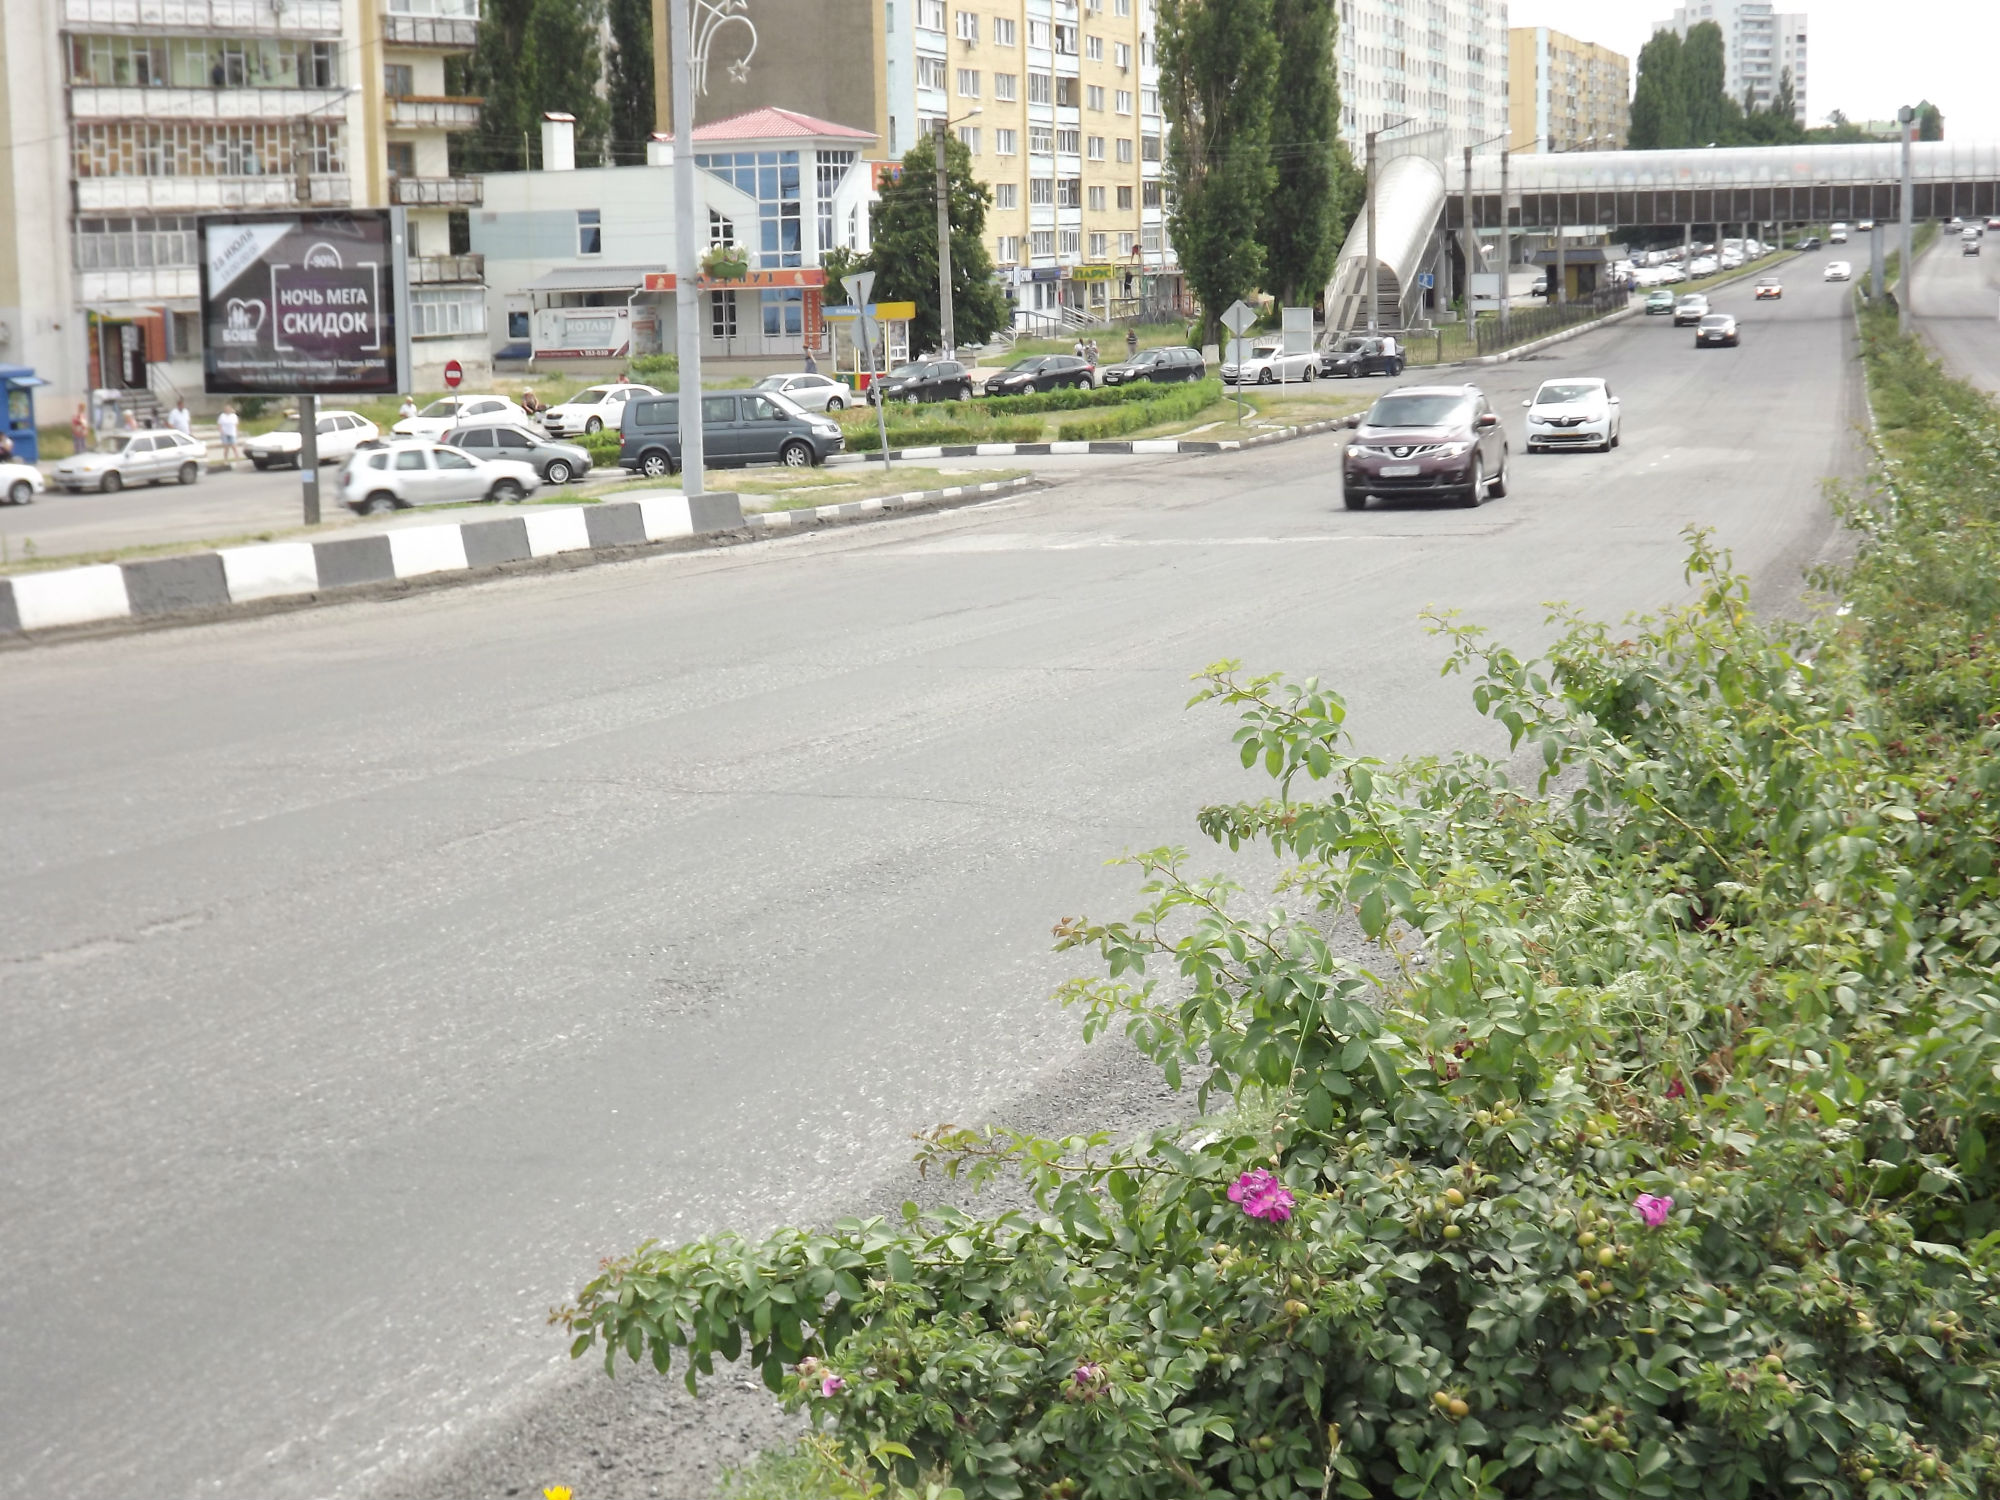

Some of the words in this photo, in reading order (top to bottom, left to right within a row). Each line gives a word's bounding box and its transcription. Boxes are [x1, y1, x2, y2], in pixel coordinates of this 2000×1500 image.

[1074, 267, 1112, 280] ПАРУС
[280, 288, 324, 306] НОЧЬ
[326, 287, 369, 305] МЕГА
[282, 311, 369, 338] СКИДОК
